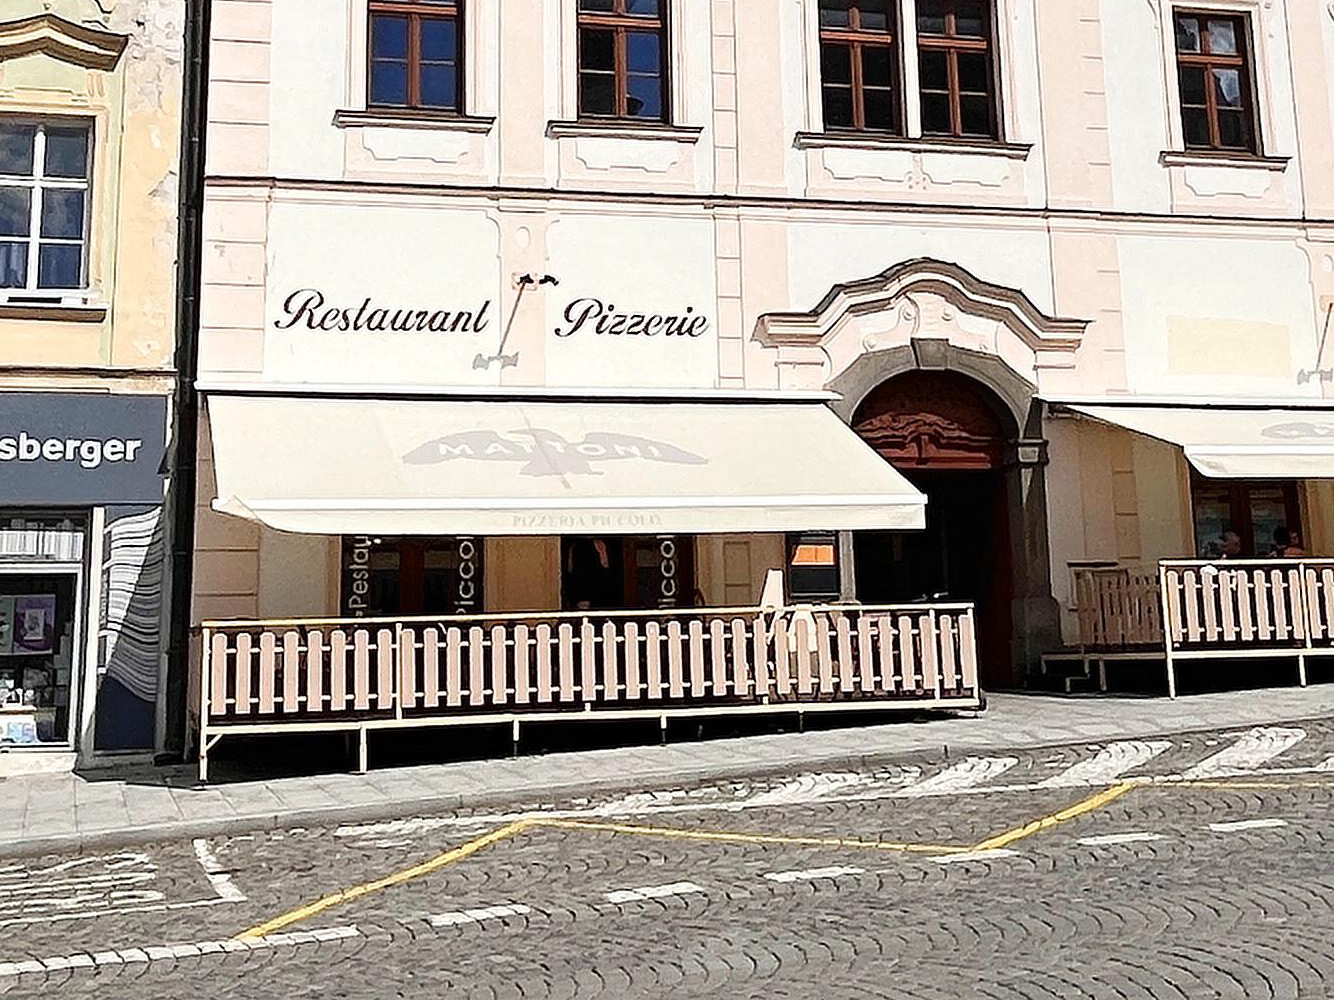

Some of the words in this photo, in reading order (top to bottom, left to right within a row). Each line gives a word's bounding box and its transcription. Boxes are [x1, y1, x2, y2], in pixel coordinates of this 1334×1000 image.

[274, 288, 492, 333] Restaurant
[554, 297, 710, 338] Pizzerie
[438, 439, 663, 458] MATTONI
